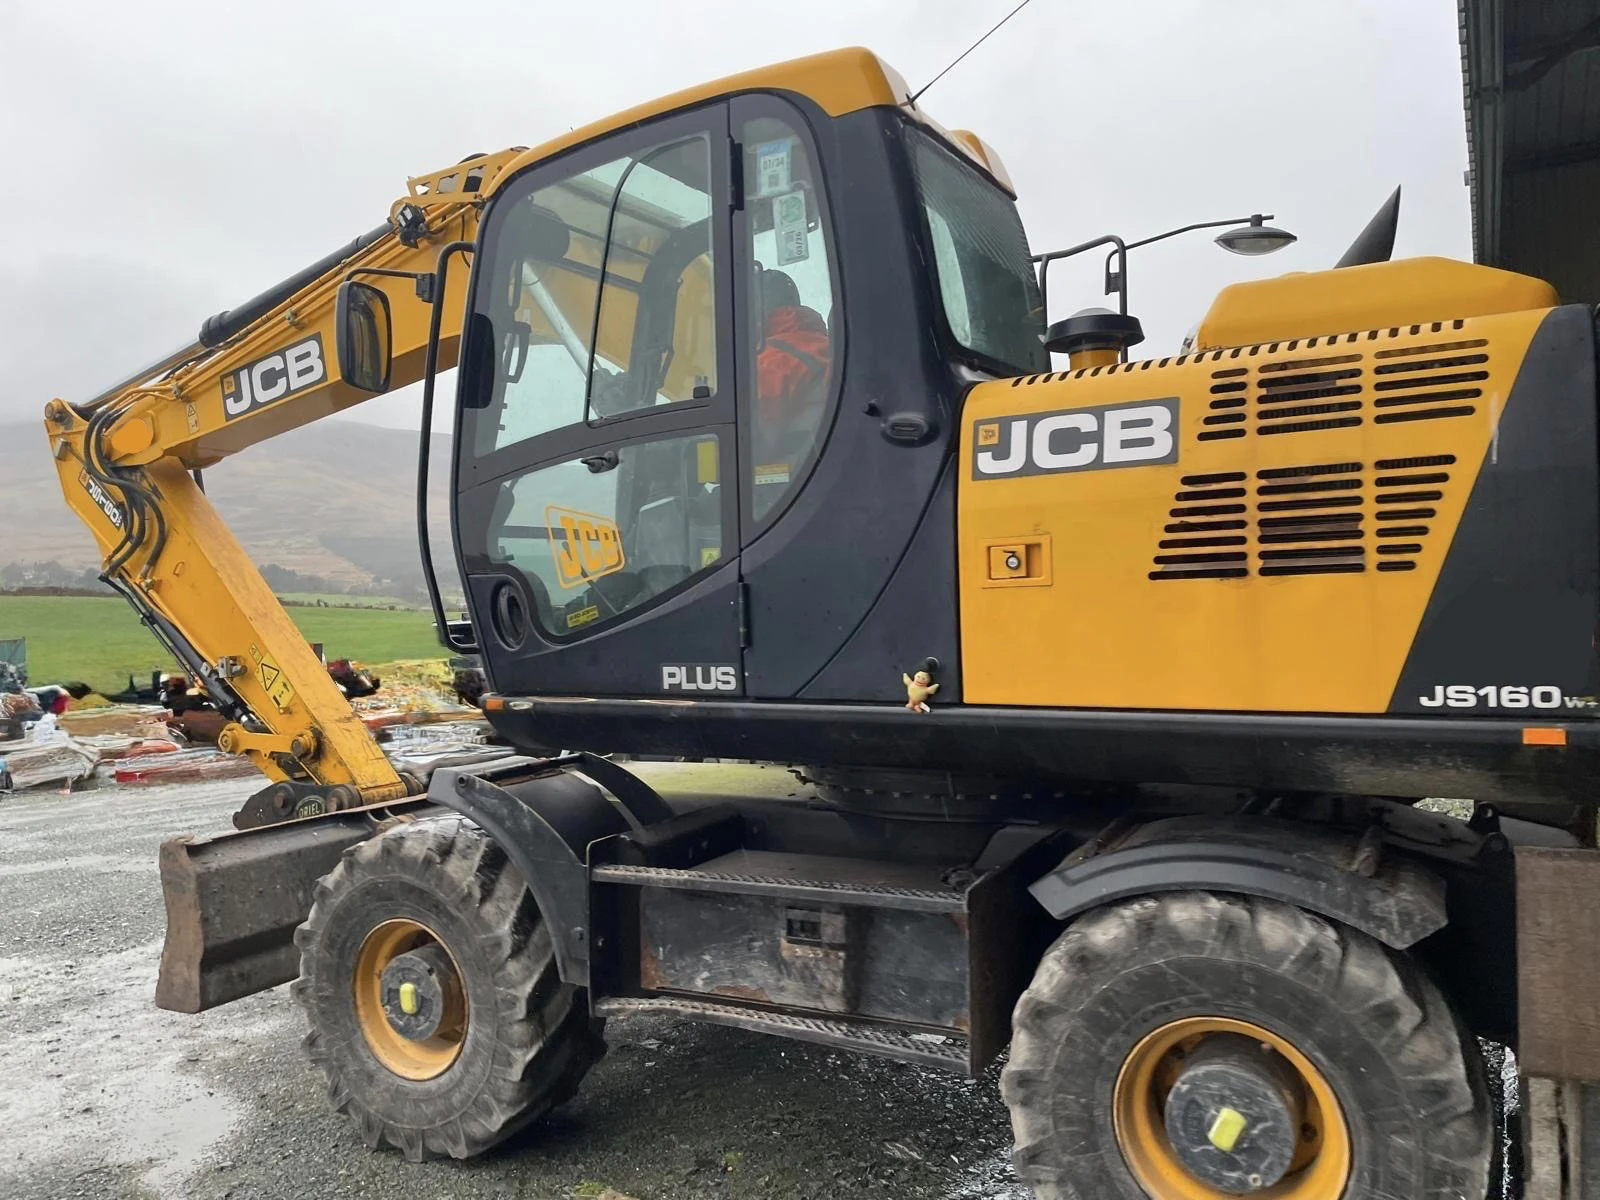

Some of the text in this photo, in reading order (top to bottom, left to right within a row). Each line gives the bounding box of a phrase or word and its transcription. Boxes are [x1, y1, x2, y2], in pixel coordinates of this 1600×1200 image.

[225, 339, 324, 415] JCB
[976, 405, 1173, 474] JCB
[559, 515, 619, 577] JCB
[662, 666, 737, 691] PLUS
